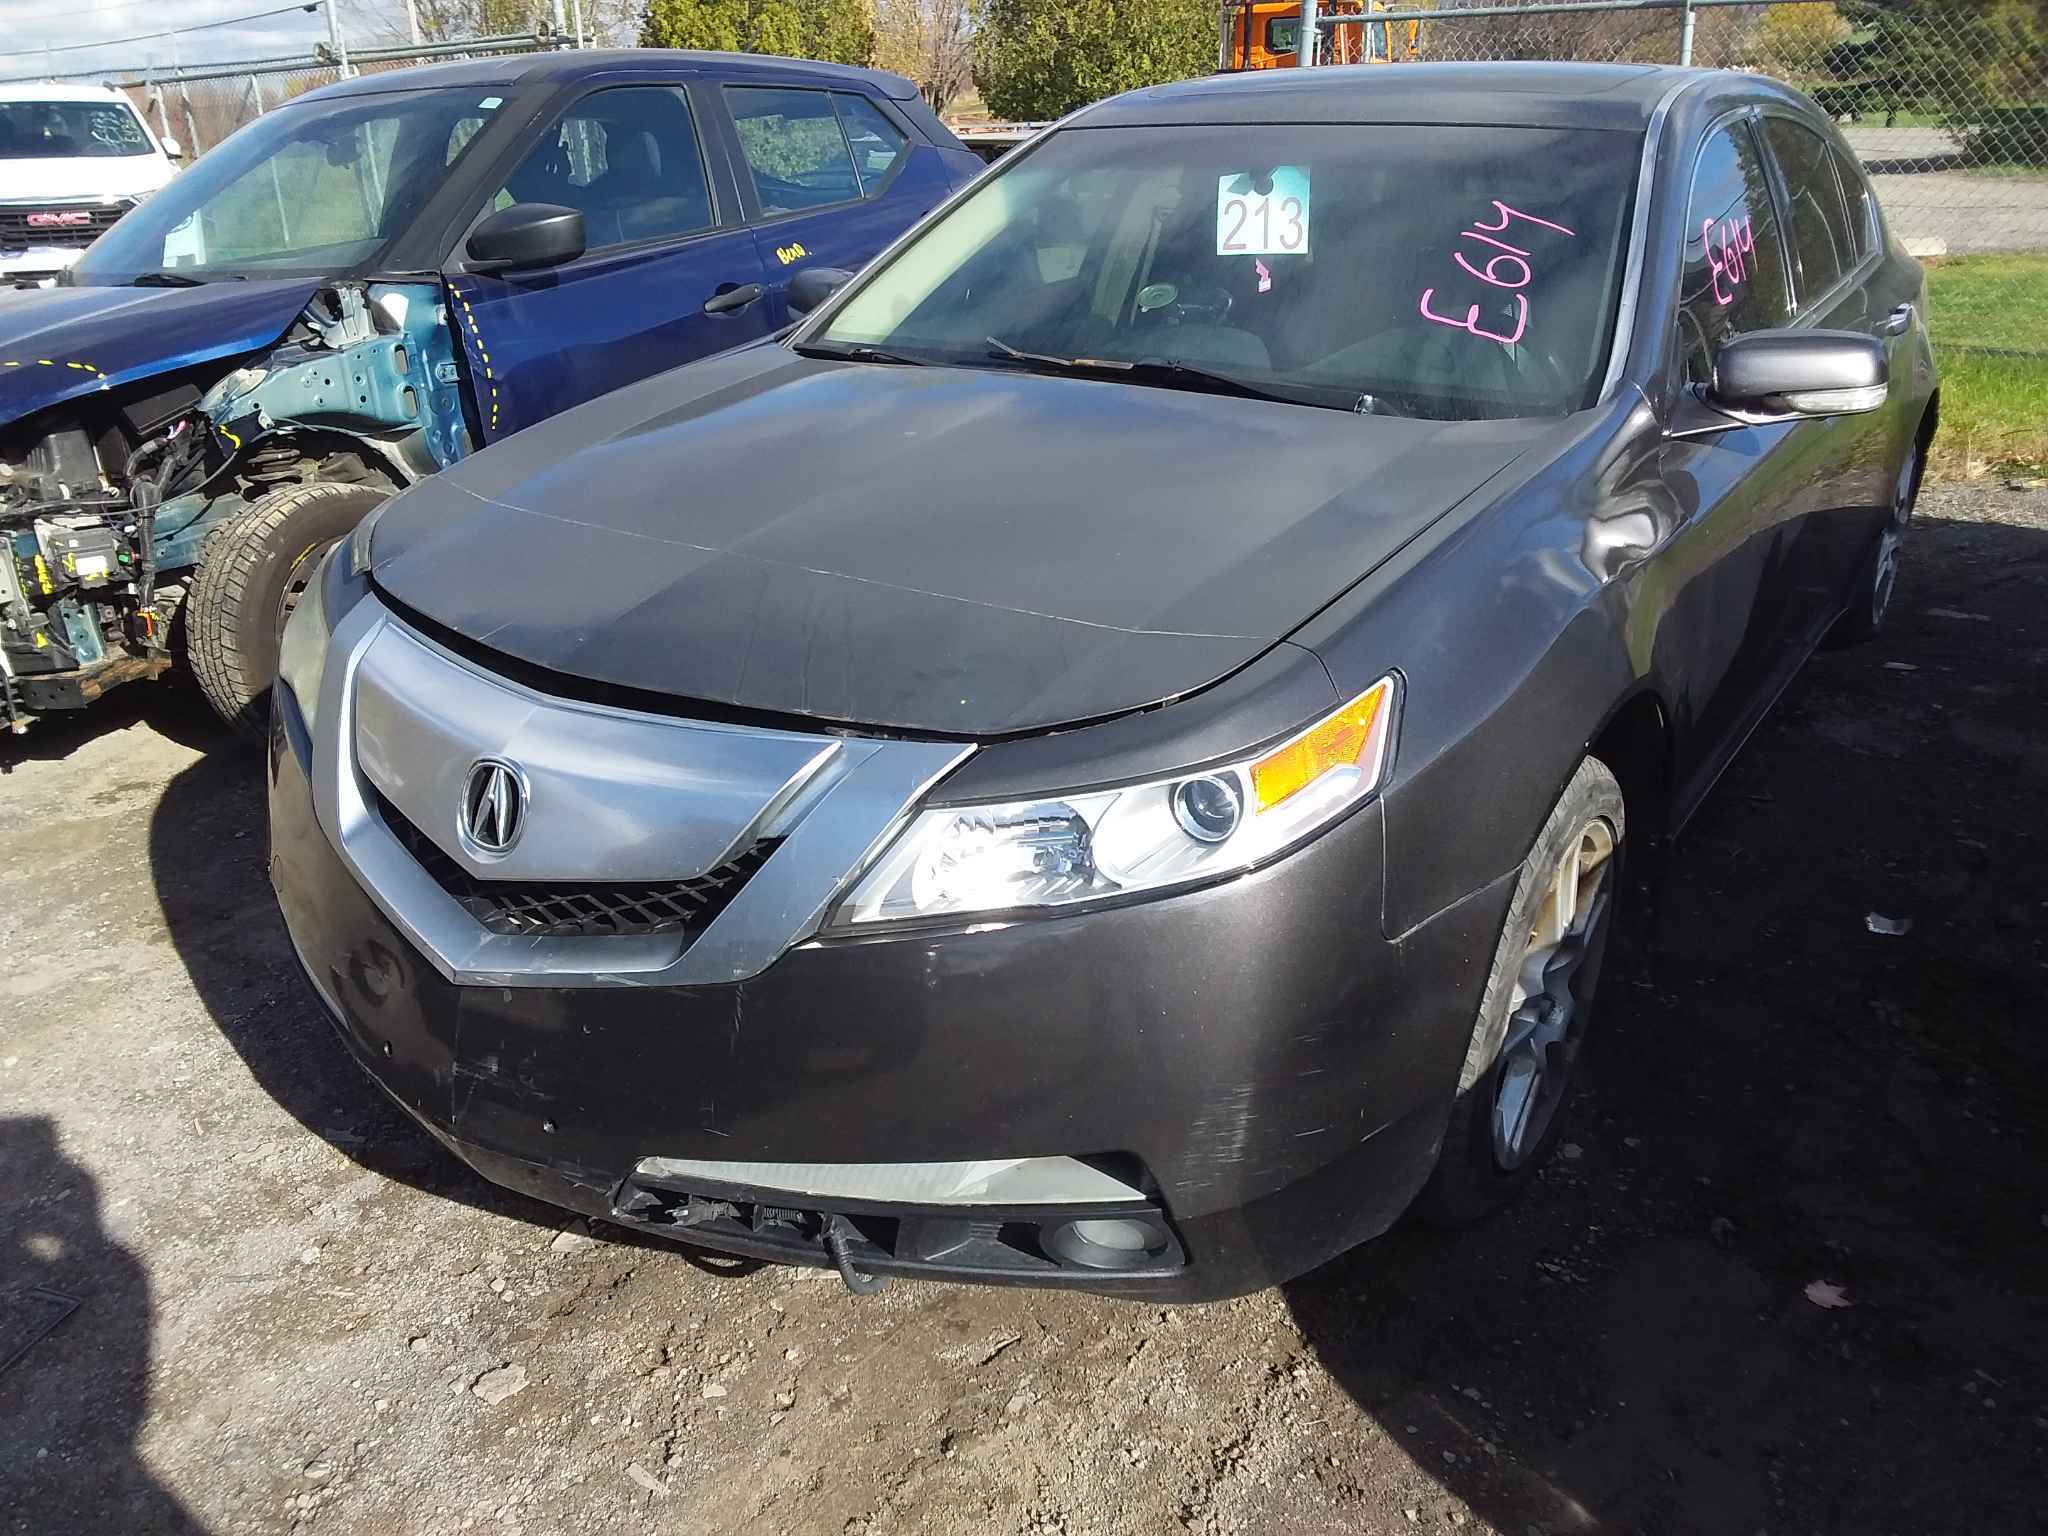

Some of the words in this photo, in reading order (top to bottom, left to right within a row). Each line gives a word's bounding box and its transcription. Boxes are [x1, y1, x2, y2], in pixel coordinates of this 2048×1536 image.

[1222, 196, 1303, 251] 213
[1702, 214, 1759, 305] E614
[1419, 199, 1577, 344] E614
